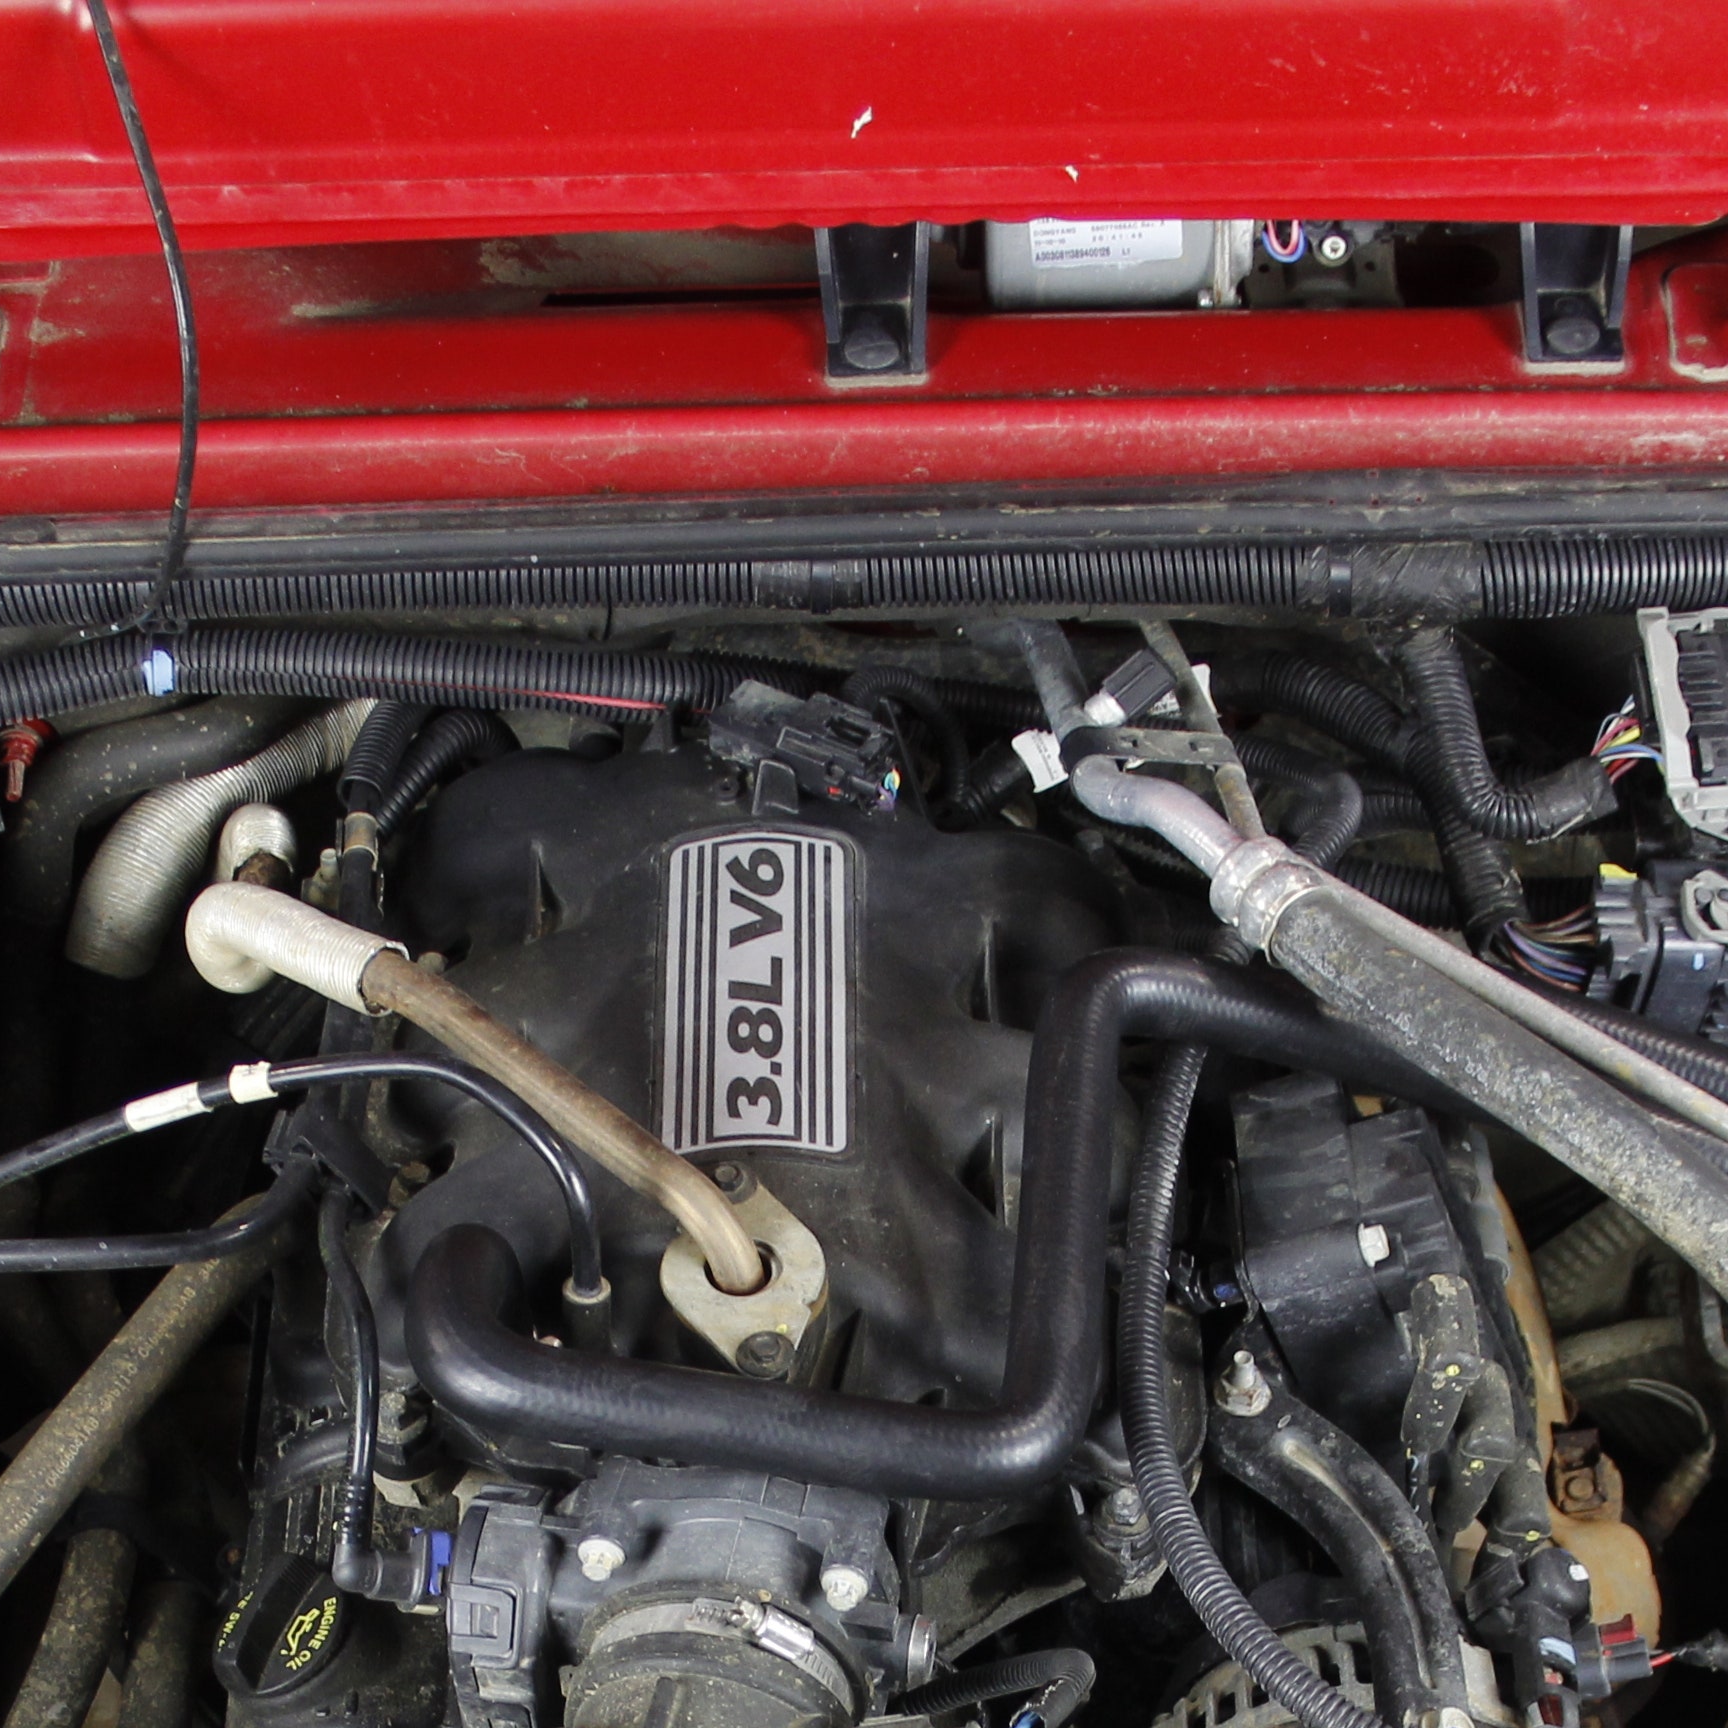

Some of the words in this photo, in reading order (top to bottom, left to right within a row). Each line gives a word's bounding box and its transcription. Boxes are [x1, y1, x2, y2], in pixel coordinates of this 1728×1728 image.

[726, 848, 784, 948] V6
[726, 956, 784, 1127] 3.8L
[286, 1650, 311, 1670] OIL
[308, 1597, 336, 1649] ENGINE
